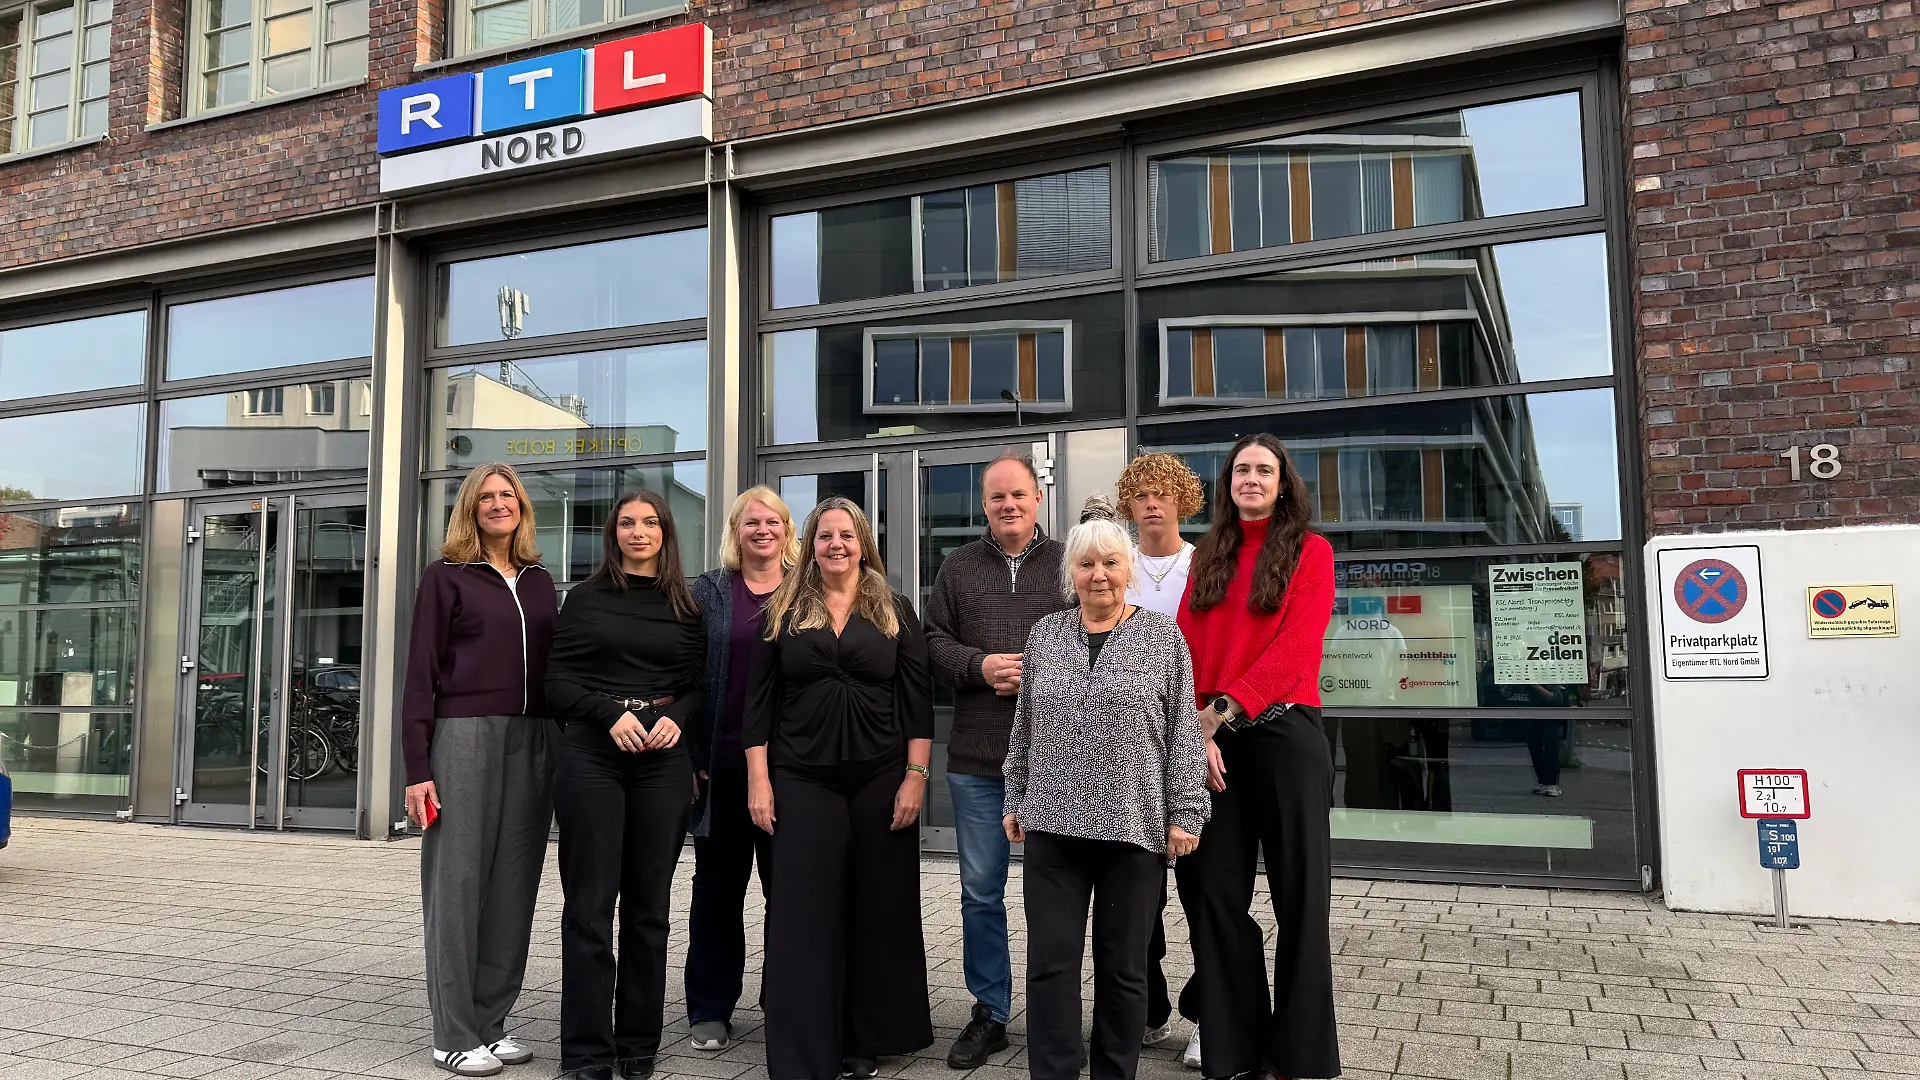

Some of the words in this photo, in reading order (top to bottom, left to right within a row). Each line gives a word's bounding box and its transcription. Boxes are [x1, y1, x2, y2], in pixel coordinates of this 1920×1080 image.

[400, 49, 667, 135] RTL
[481, 126, 585, 170] NORD
[1781, 443, 1842, 482] 18
[1426, 566, 1441, 578] 18
[1493, 567, 1579, 582] Zwischen
[1347, 620, 1390, 631] NORD
[1548, 631, 1582, 645] den
[1670, 633, 1758, 650] Privatparkplatz
[1342, 651, 1373, 659] network
[1399, 651, 1457, 659] nachtblau
[1527, 646, 1584, 661] Zeilen
[1672, 658, 1708, 669] Eigentümer
[1709, 658, 1722, 666] RTL
[1723, 658, 1739, 666] Nord
[1740, 657, 1760, 665] GmbH
[1338, 679, 1372, 689] SCHOOL
[1409, 680, 1460, 688] gastrorocket
[1780, 833, 1796, 842] 100
